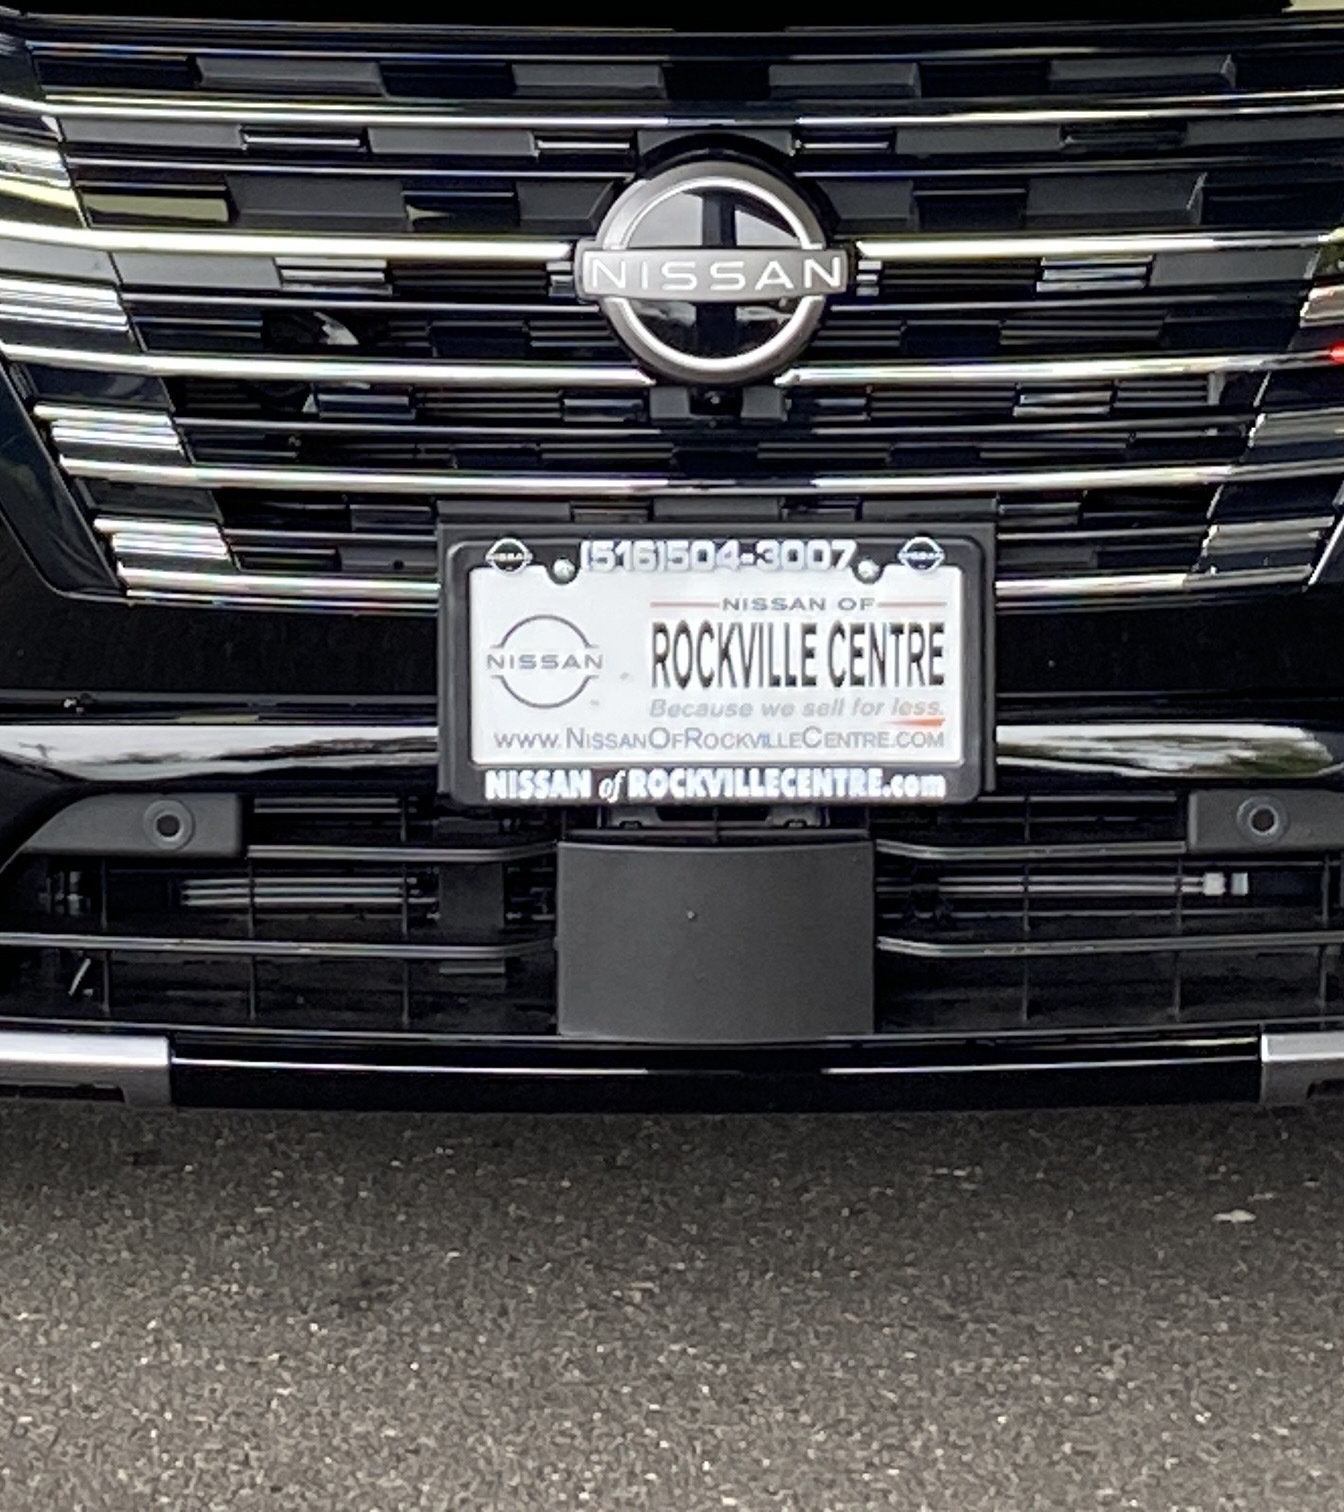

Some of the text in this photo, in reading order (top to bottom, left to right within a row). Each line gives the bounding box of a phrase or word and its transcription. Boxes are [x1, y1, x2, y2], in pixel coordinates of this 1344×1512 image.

[592, 257, 841, 291] NISSAN
[721, 597, 876, 611] NISSAN OF
[486, 653, 604, 671] NISSAN
[651, 619, 946, 689] ROCKVILLE CENTRE
[649, 698, 753, 719] Because
[761, 702, 795, 718] we
[853, 697, 885, 717] for
[484, 767, 947, 804] NISSAN of ROCKVILLECENTRE.com
